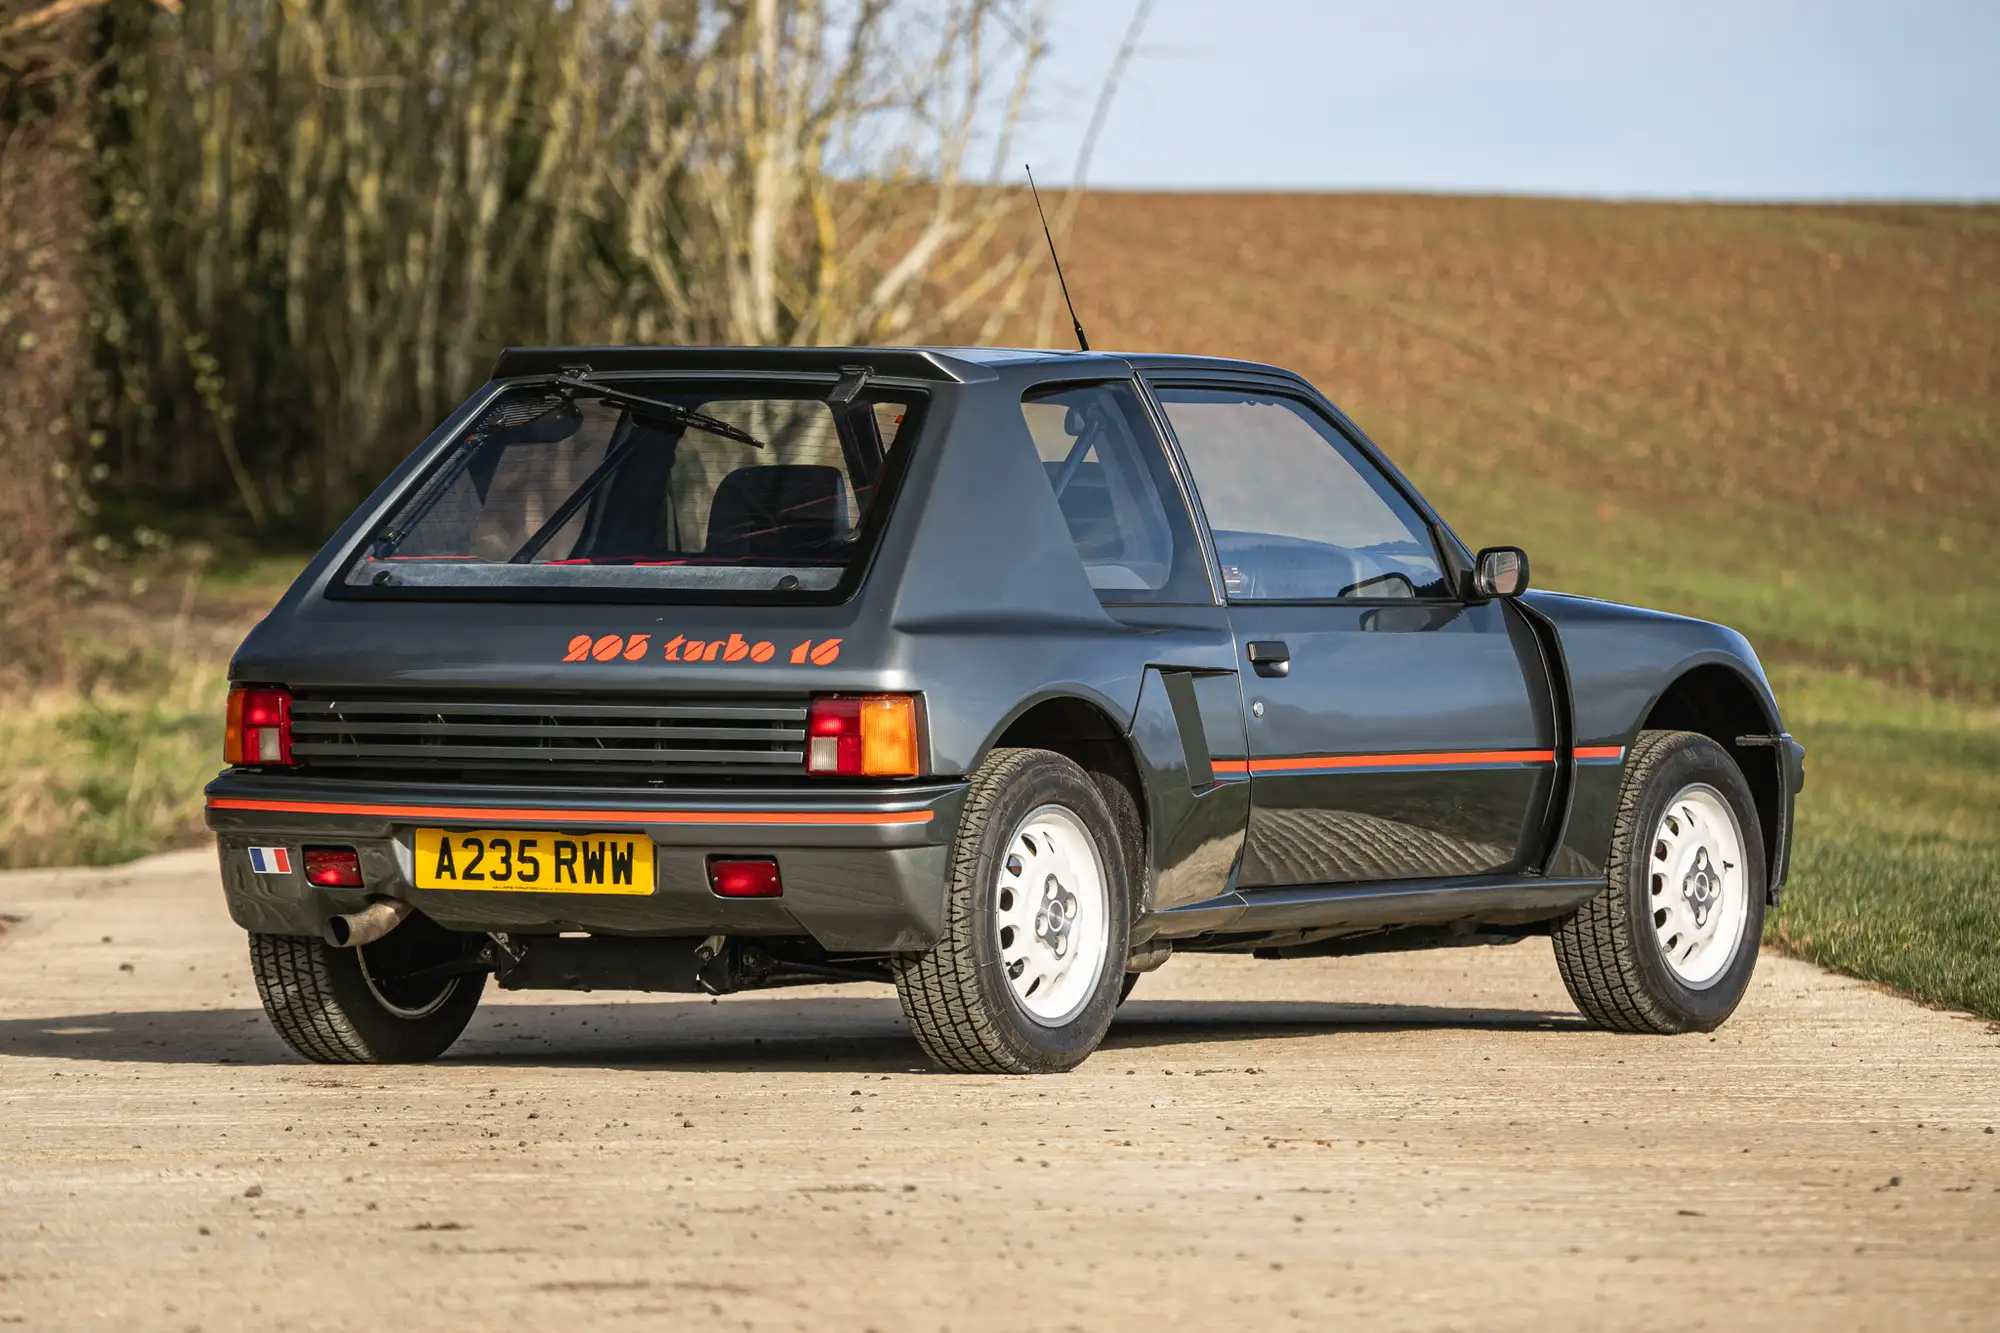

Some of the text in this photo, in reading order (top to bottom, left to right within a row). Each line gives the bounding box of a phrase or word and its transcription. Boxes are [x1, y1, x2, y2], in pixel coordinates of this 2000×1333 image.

[561, 633, 843, 666] 205 turbo 16
[435, 836, 634, 885] A235 RWW
